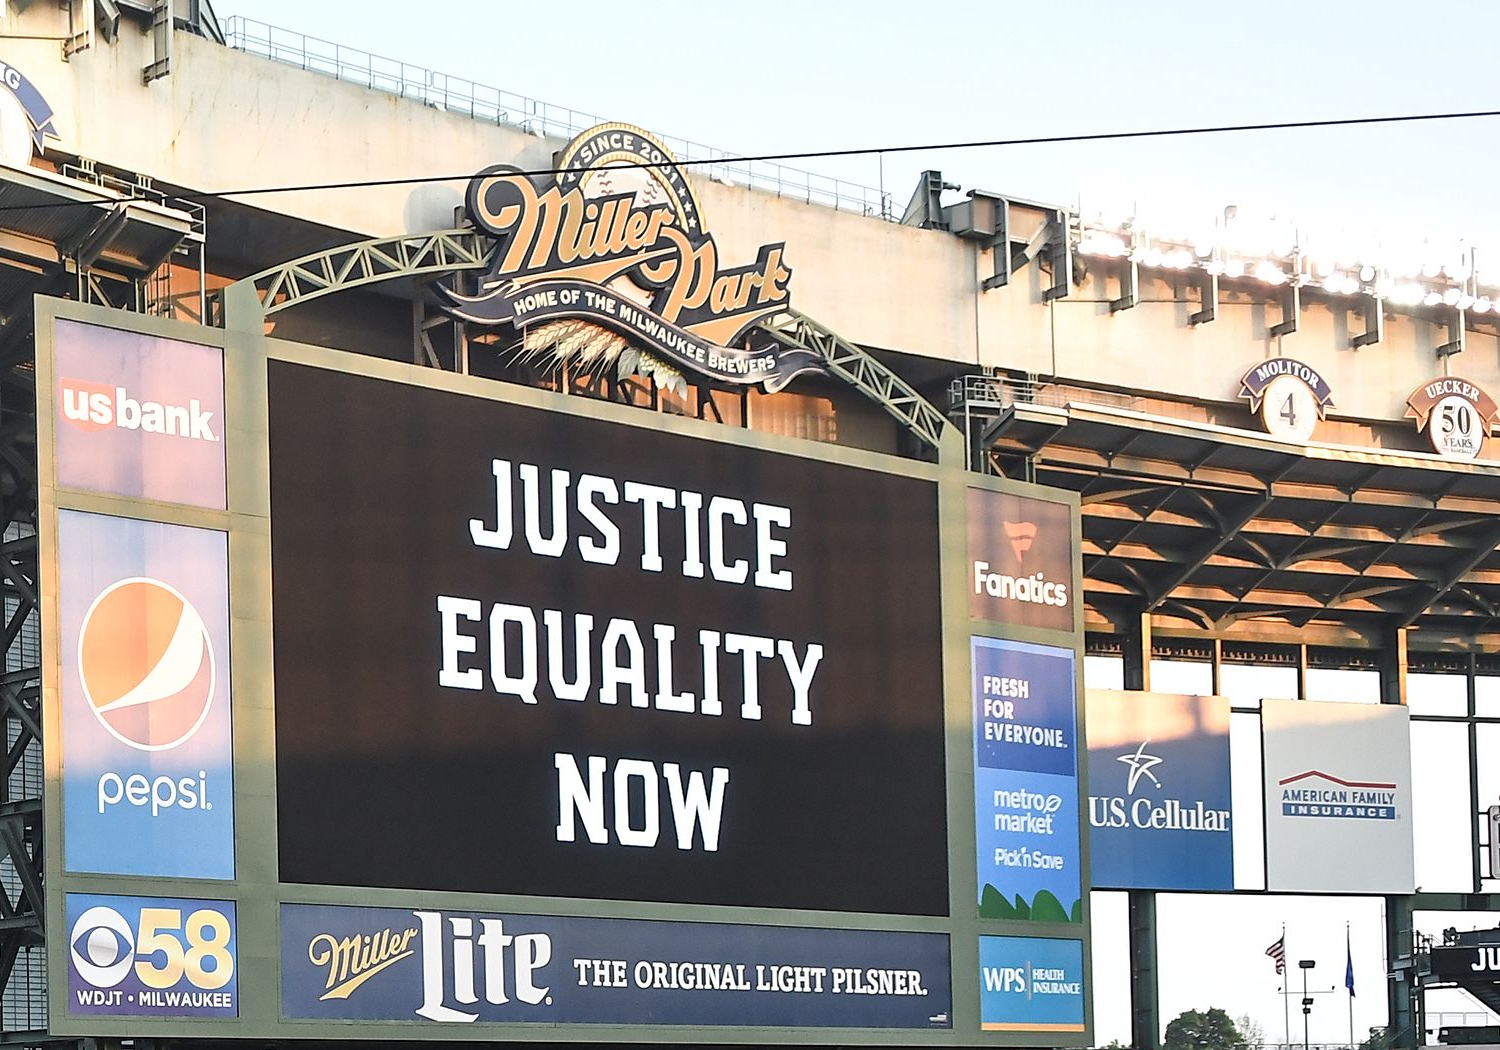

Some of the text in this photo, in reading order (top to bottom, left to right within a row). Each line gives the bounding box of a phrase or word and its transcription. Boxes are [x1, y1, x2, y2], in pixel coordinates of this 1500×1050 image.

[580, 133, 678, 184] SINCE 2001
[476, 171, 675, 276] Miller
[638, 227, 790, 324] Park
[513, 289, 776, 374] HOME OF THE MILWAUKEE BREWERS
[1256, 360, 1320, 390] MOLITOR
[1424, 379, 1480, 402] UECKER
[1279, 392, 1297, 427] 4
[1441, 405, 1471, 435] 50
[468, 458, 793, 591] JUSTICE
[973, 560, 1068, 607] Fanatics
[437, 595, 824, 726] EQUALITY
[983, 675, 1029, 699] FRESH
[983, 698, 1014, 720] FOR
[984, 721, 1068, 748] EVERYONE.
[98, 770, 212, 816] pepsi
[554, 752, 730, 853] NOW
[993, 788, 1045, 811] metro
[1282, 789, 1396, 805] AMERICAN FAMILY
[994, 811, 1054, 835] market
[1087, 796, 1230, 832] U.S. Cellular
[1290, 805, 1388, 818] INSURANCE
[1032, 850, 1064, 870] Save
[134, 907, 235, 990] 58
[308, 910, 553, 1024] Miller Lite
[573, 958, 929, 996] THE ORIGINAL LIGHT PILSNER.
[983, 966, 1027, 993] WPS
[1032, 968, 1065, 981] HEALTH
[76, 990, 232, 1008] WDJT MILWAUKEE
[1032, 981, 1081, 995] INSURANCE
